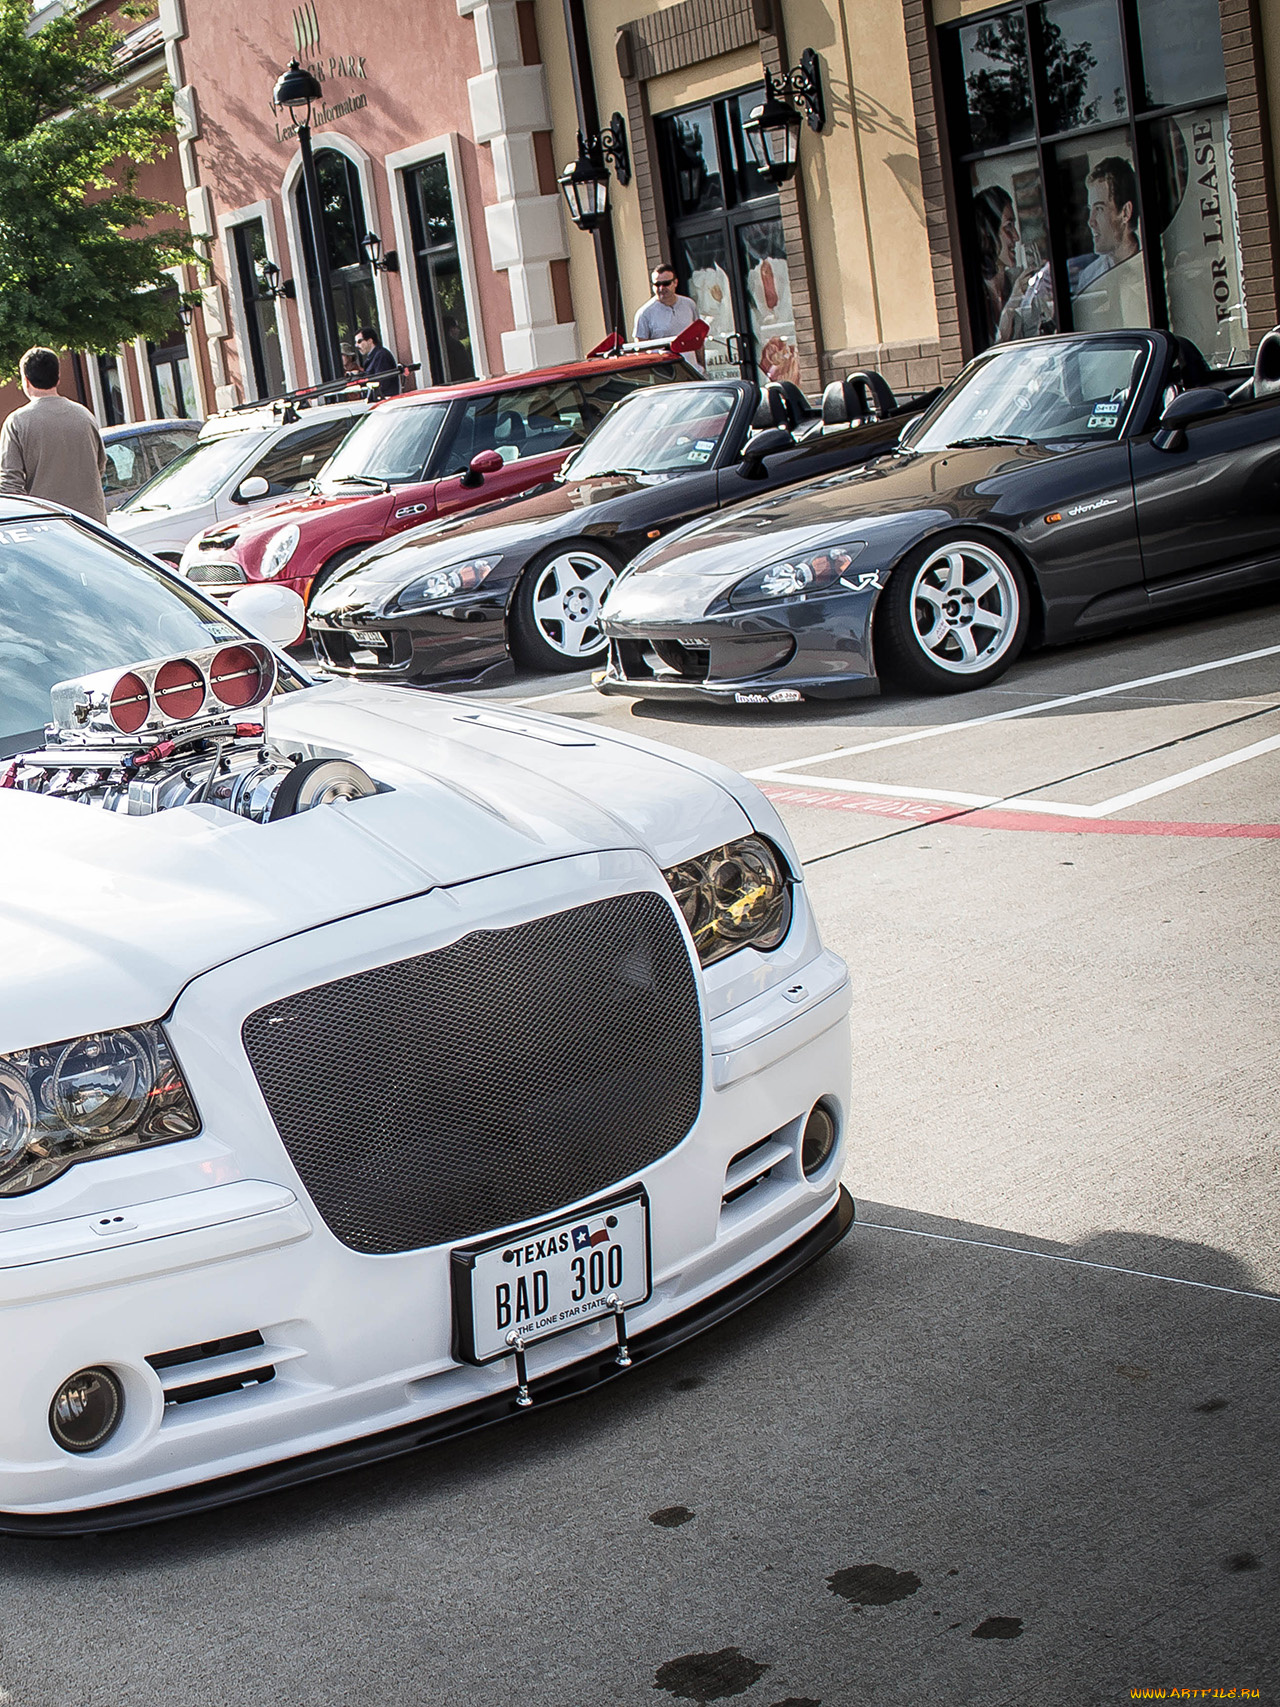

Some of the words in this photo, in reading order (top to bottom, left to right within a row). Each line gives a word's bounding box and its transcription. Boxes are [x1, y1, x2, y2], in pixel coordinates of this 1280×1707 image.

[329, 56, 367, 79] PARK
[312, 88, 368, 128] Information
[1192, 118, 1224, 246] LEASE
[1212, 256, 1232, 323] FOR
[1068, 499, 1118, 516] Honda
[842, 799, 943, 817] ZONE
[513, 1232, 569, 1267] TEXAS
[495, 1270, 549, 1331] BAD
[571, 1244, 623, 1302] 300
[518, 1321, 535, 1336] THE
[536, 1314, 558, 1330] LONE
[559, 1307, 581, 1323] STAR
[581, 1296, 607, 1314] STATE
